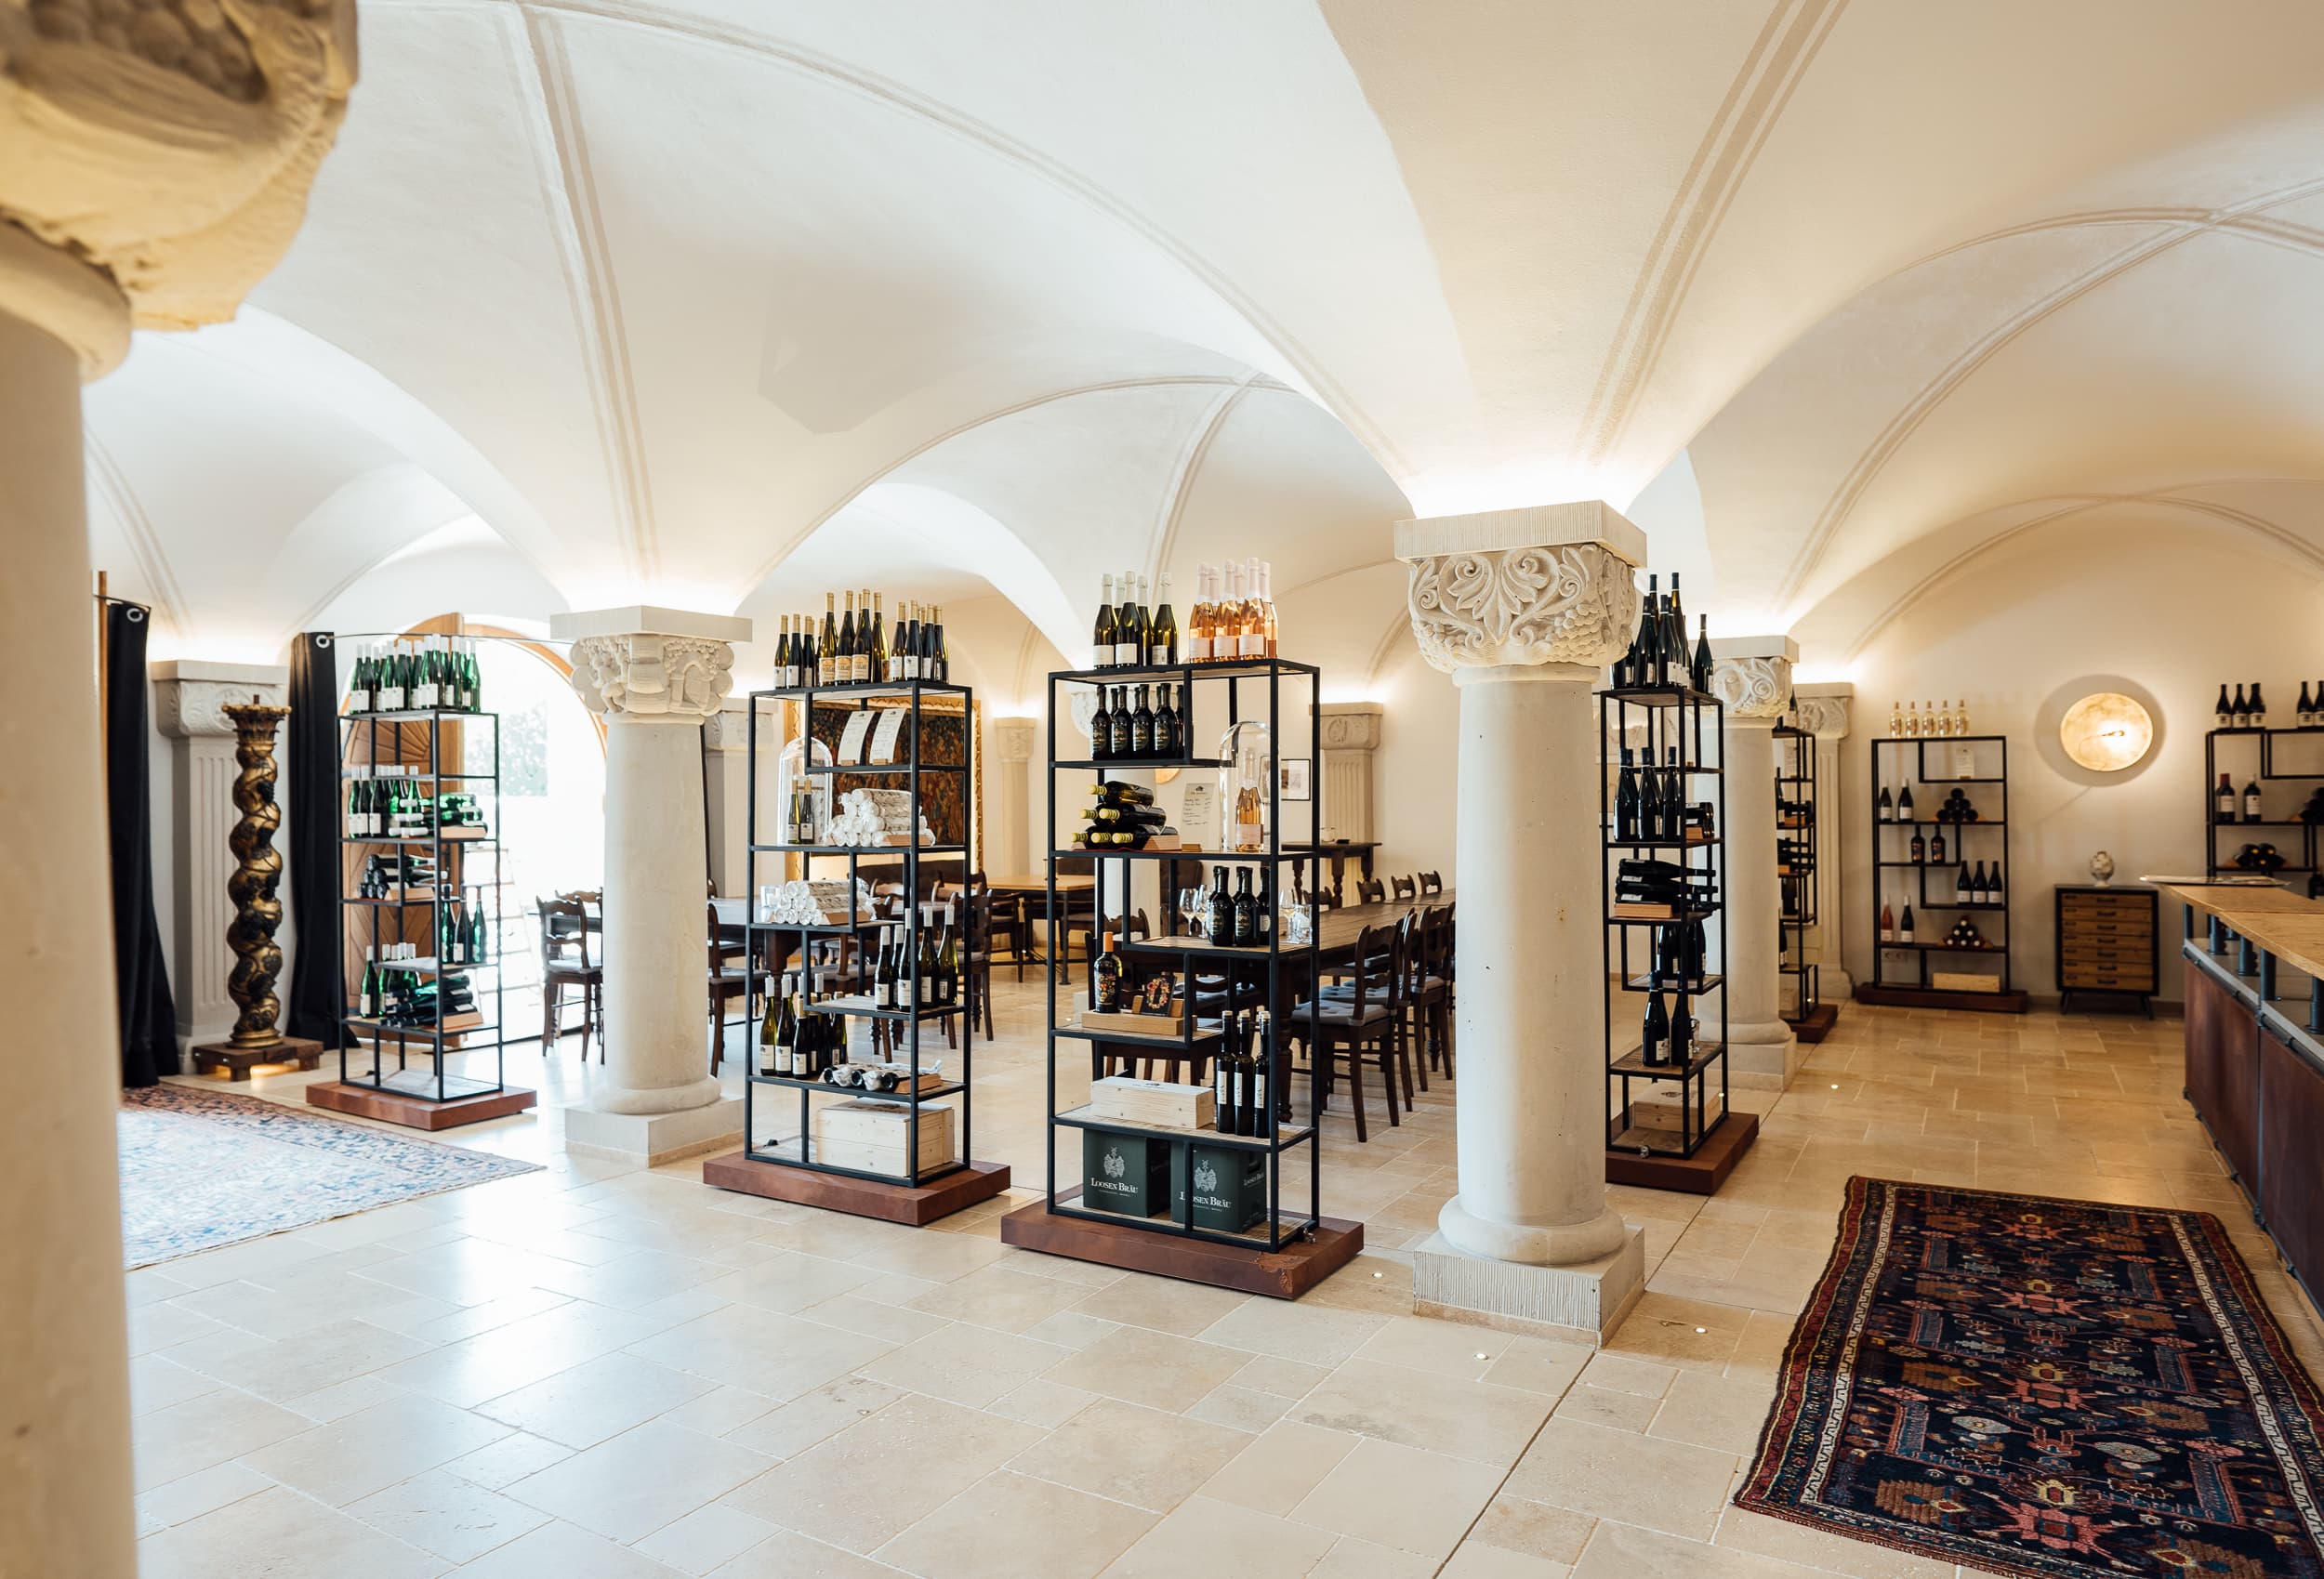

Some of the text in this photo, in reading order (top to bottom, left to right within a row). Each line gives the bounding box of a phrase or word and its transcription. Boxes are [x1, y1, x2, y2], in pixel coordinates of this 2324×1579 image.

[1090, 1177, 1118, 1191] LOOSEN
[1118, 1182, 1139, 1194] BRÄU
[1179, 1191, 1209, 1204] LSEN
[1209, 1196, 1233, 1209] BRÄU
